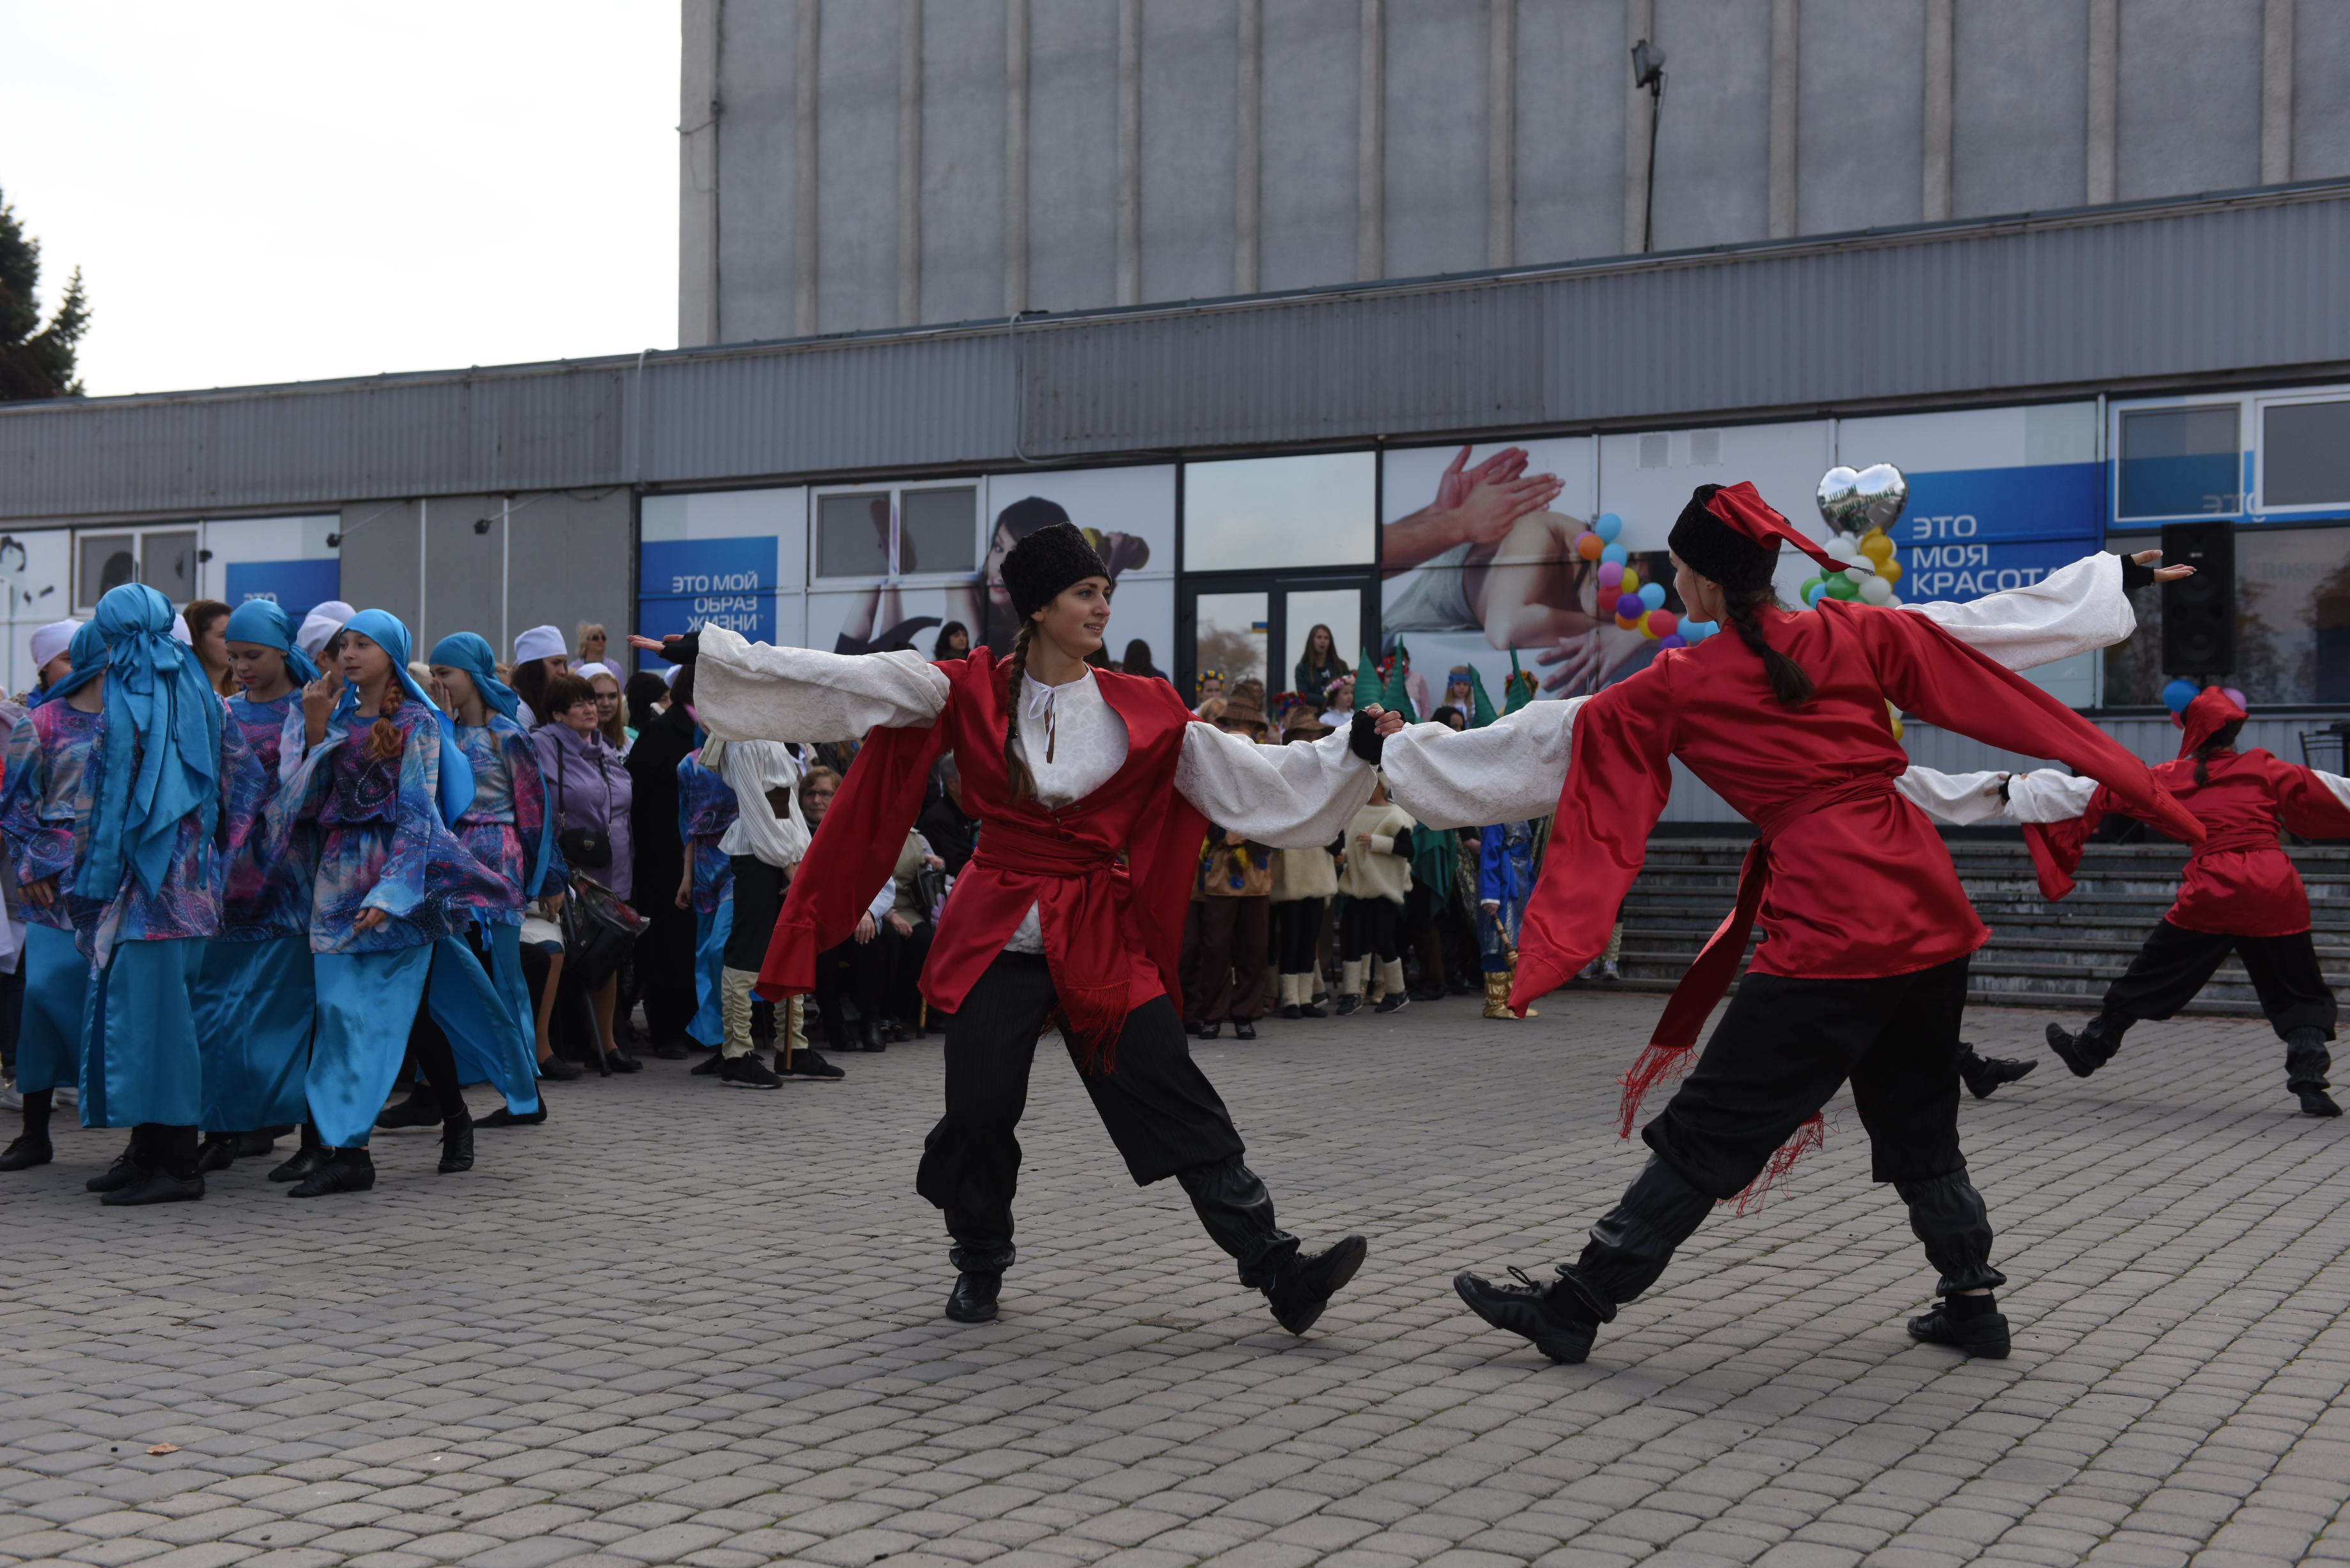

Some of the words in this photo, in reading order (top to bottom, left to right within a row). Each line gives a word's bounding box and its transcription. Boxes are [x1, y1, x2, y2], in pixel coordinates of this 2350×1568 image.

[1913, 515, 1977, 539] ЭТО
[1913, 544, 1988, 569] МОЯ
[672, 575, 709, 594] ЭТО
[713, 570, 758, 591] МОЙ
[694, 595, 758, 614] ОБРАЗ
[686, 614, 758, 633] ЖИЗНИ
